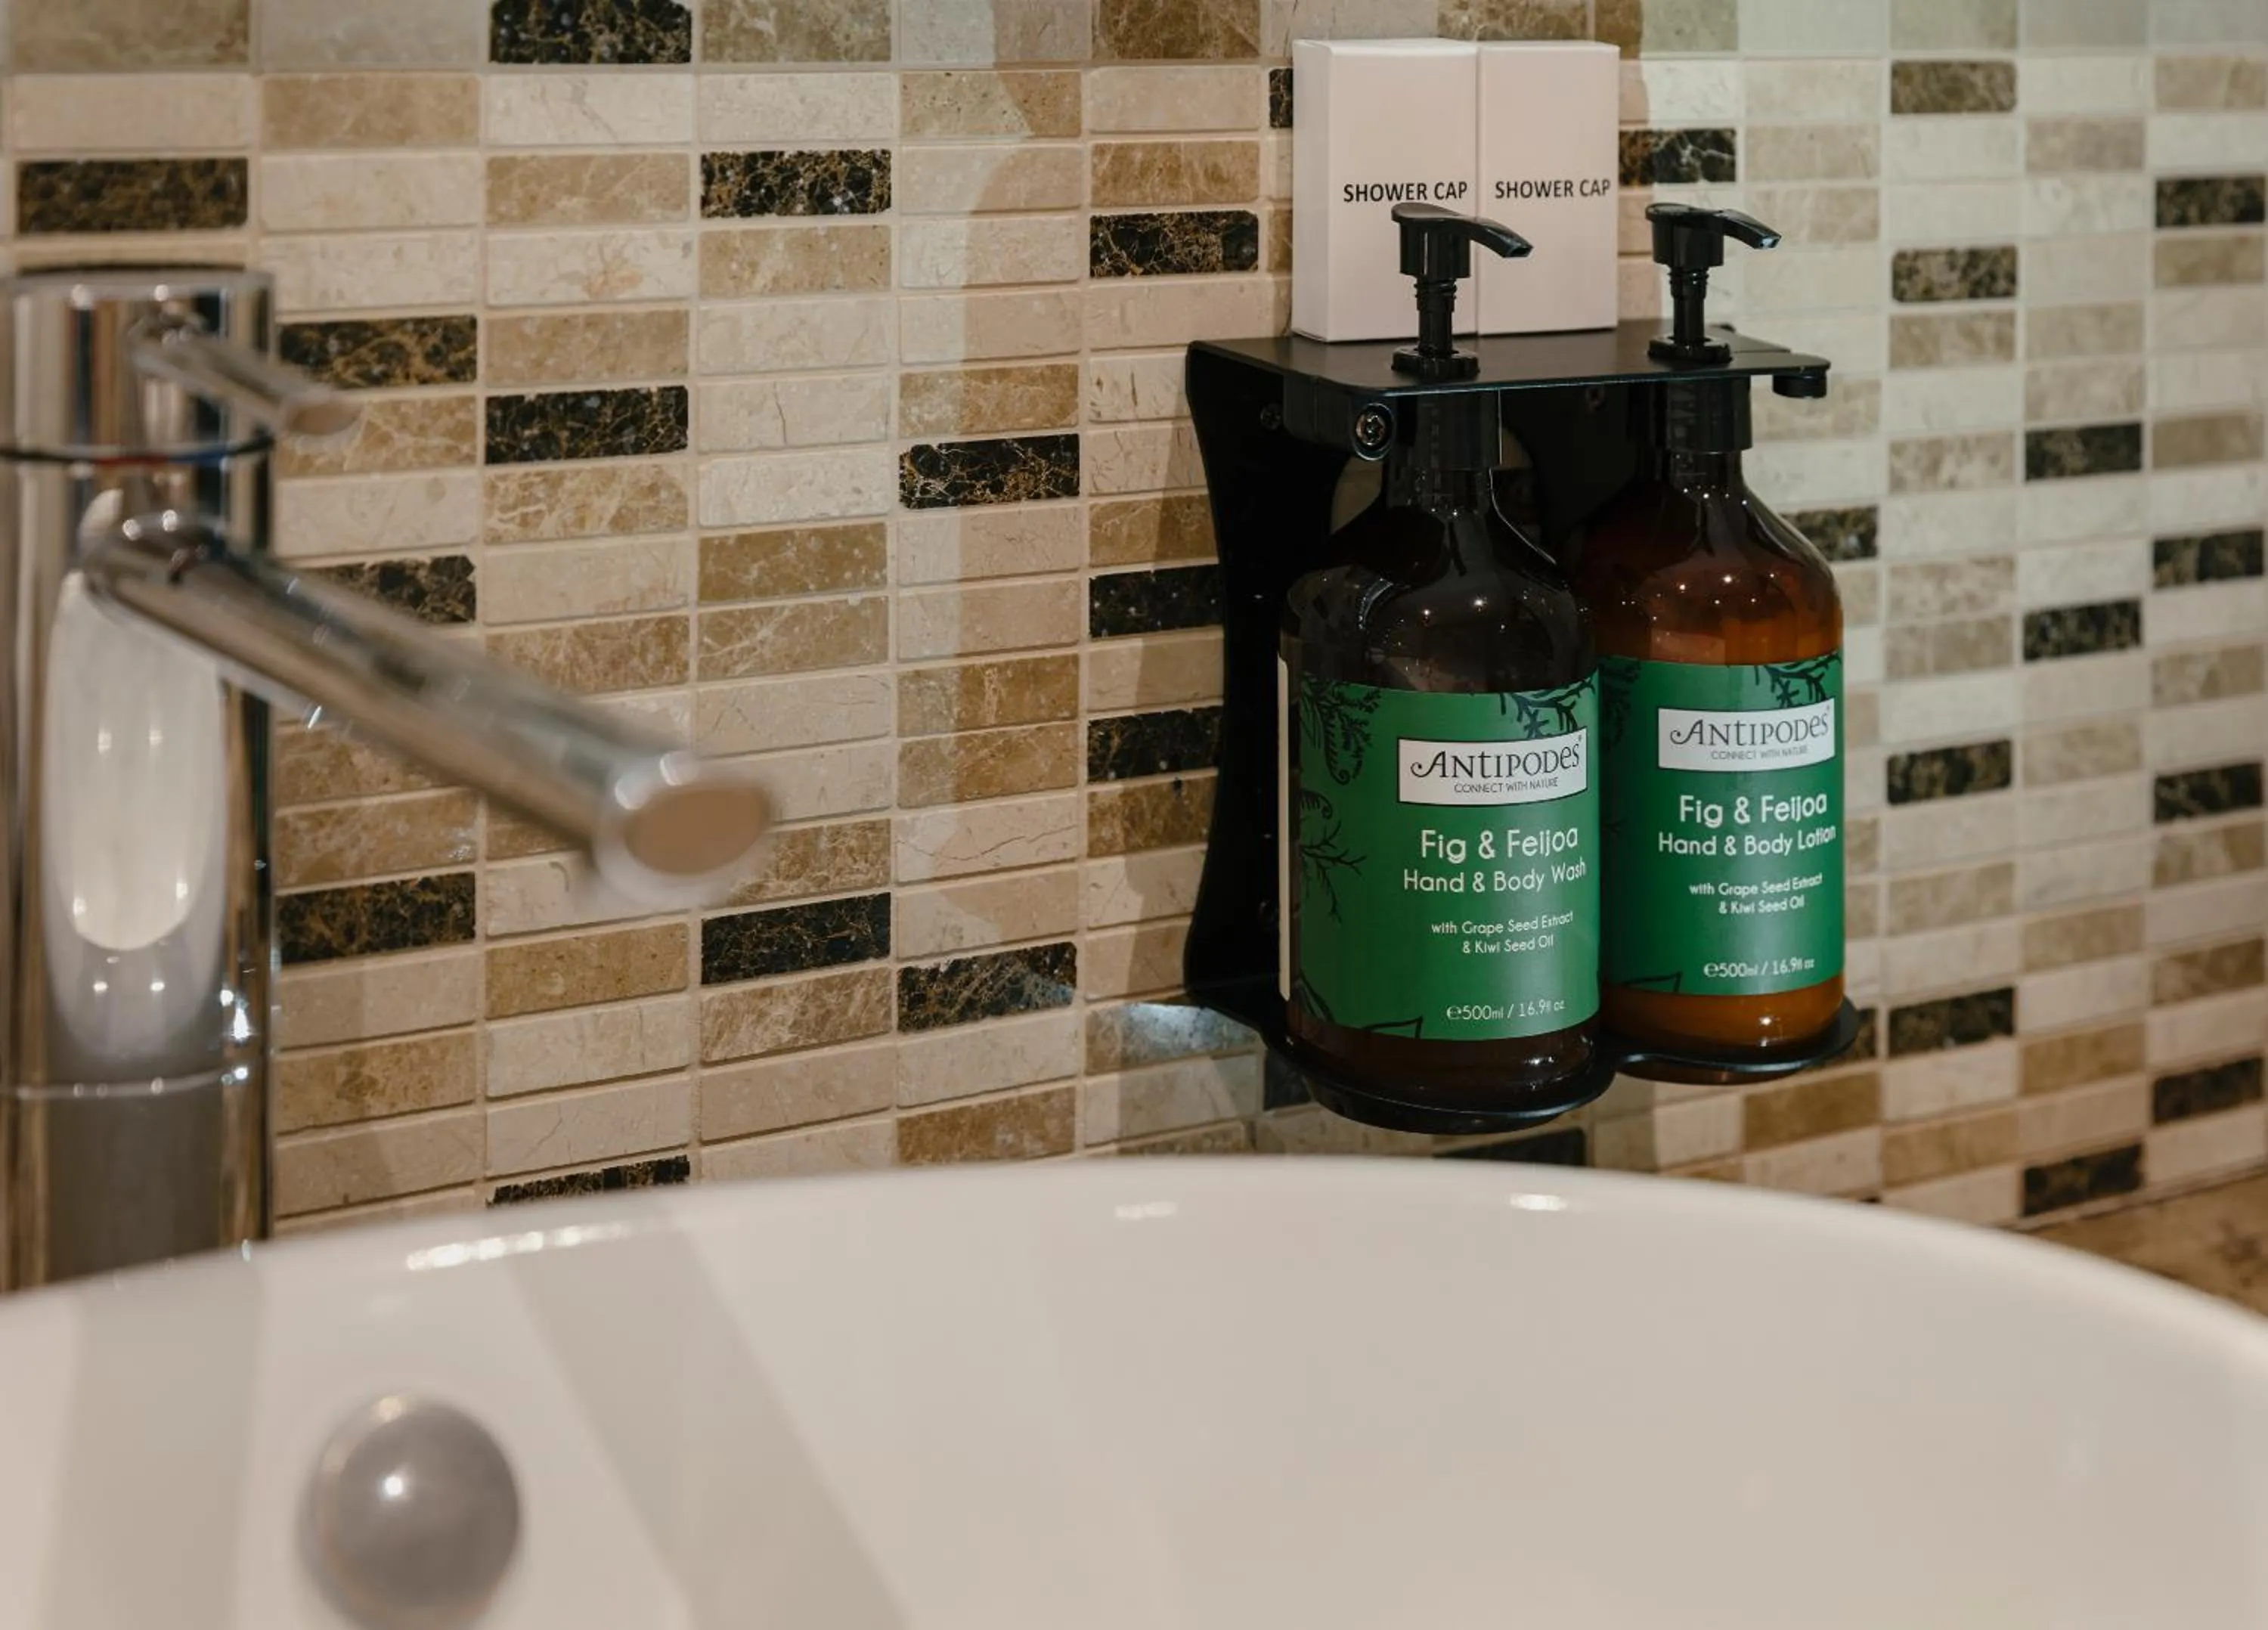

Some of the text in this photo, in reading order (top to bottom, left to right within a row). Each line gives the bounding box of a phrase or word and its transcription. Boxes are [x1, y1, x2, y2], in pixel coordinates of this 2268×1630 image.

[1343, 181, 1467, 203] SHOWER CAP
[1495, 178, 1610, 199] SHOWER CAP
[1711, 750, 1757, 761] CONNECT
[1760, 749, 1780, 759] WITH
[1454, 776, 1558, 794] CONNECT WITH NATURE
[1680, 793, 1827, 829] Fig & Feijoa
[1421, 827, 1579, 864] Fig & Feijoa
[1659, 826, 1836, 856] Hand & Body Lotion
[1404, 856, 1586, 893] Hand & Body Wash
[1689, 882, 1715, 895] with
[1718, 882, 1758, 898] Grape
[1761, 879, 1791, 894] Seed
[1718, 894, 1805, 915] & Kiwi Seed Oil
[1431, 910, 1574, 937] with Grape Seed Extract
[1462, 934, 1554, 954] & Kiwi Seed Oil
